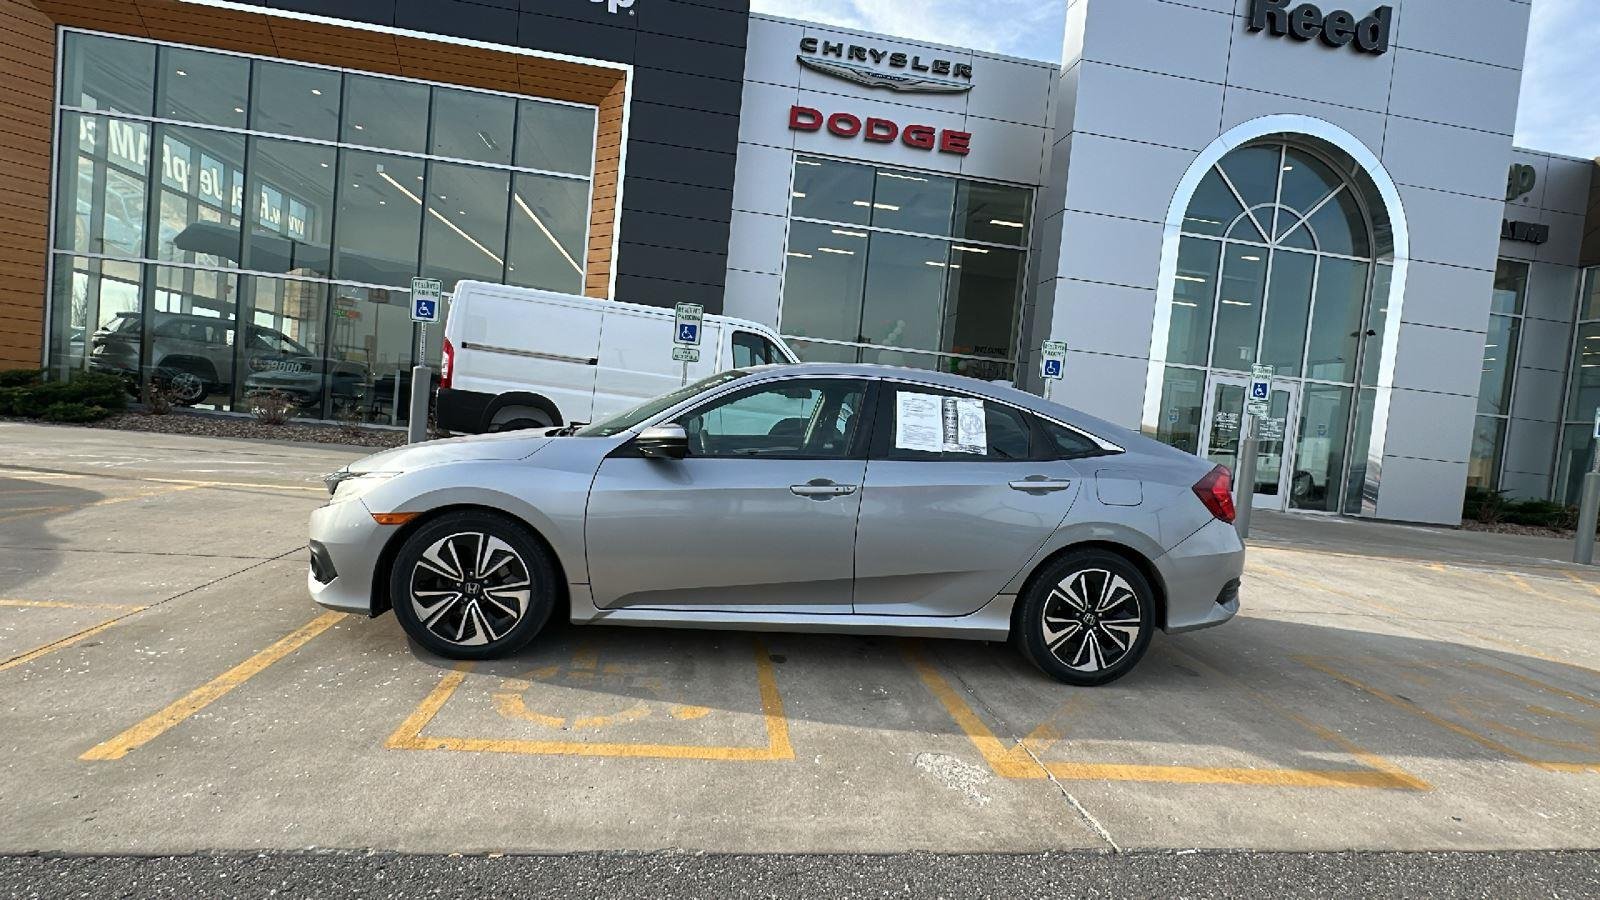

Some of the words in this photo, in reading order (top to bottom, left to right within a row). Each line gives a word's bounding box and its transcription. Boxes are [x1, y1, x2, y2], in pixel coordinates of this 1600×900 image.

[1247, 0, 1392, 55] Reed
[800, 37, 972, 78] CHRYSLER
[789, 105, 972, 155] DODGE
